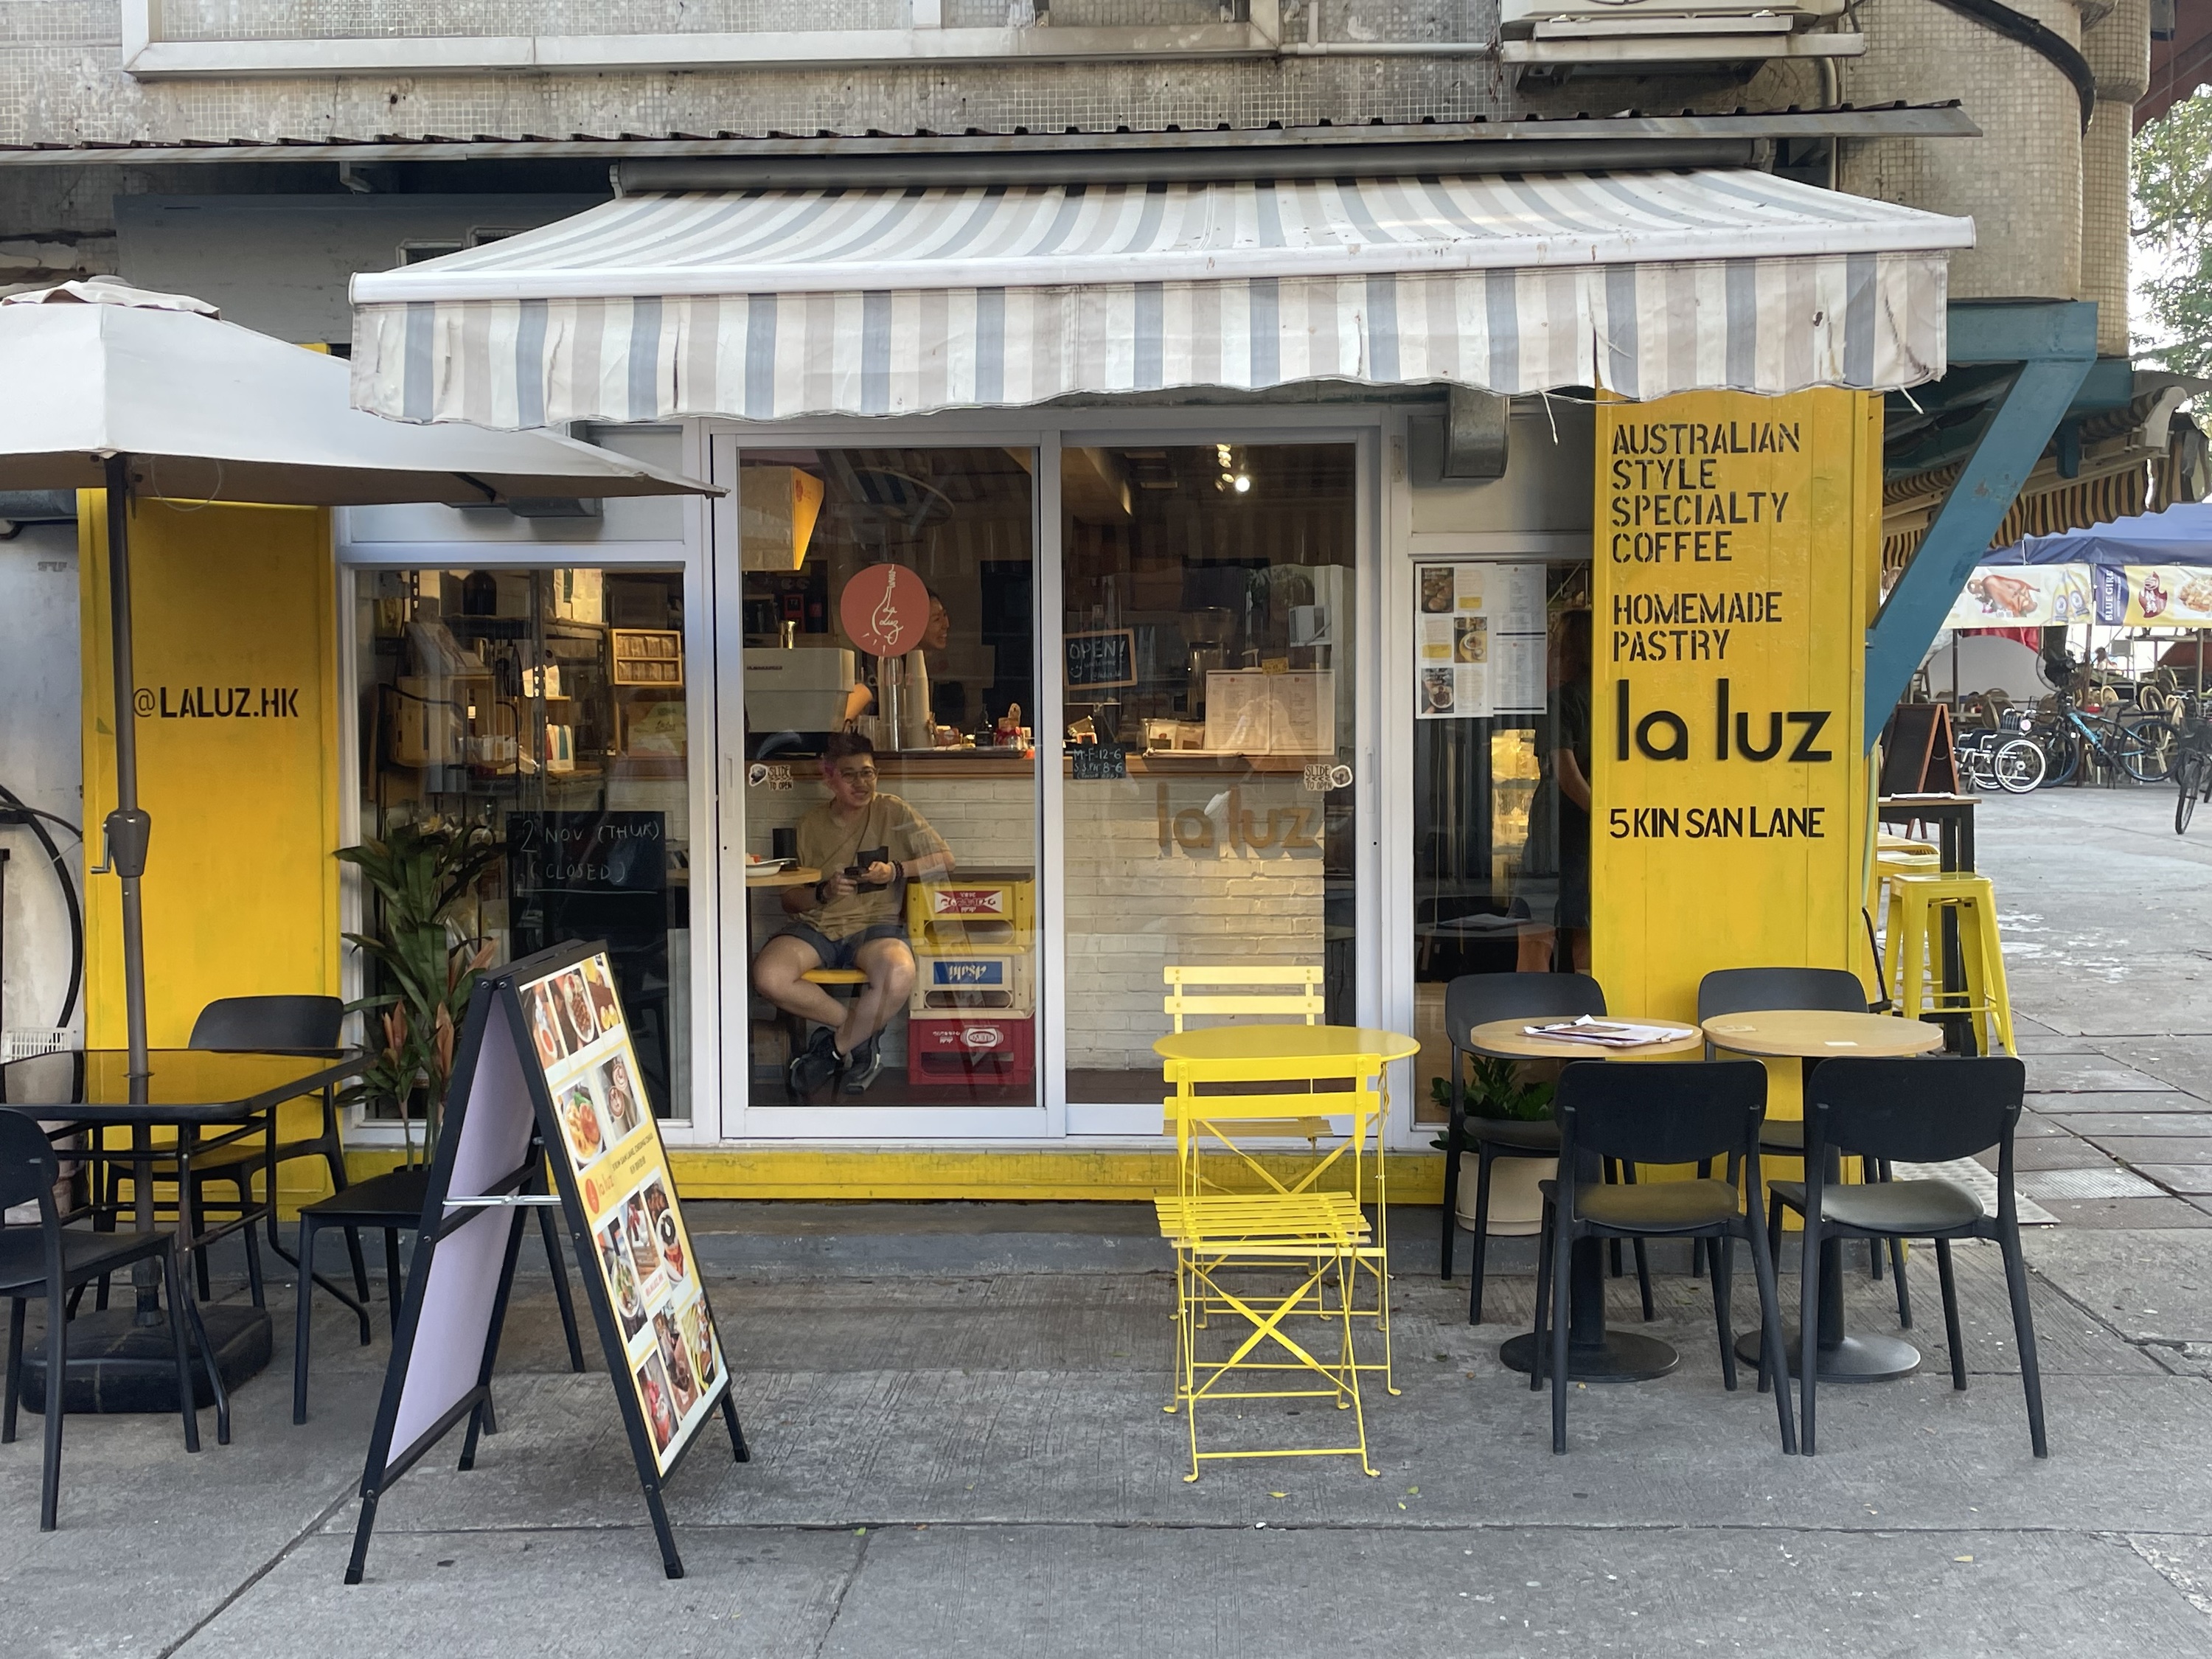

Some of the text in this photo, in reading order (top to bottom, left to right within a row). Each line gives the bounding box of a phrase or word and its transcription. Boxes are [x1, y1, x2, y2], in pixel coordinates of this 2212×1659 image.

[1613, 421, 1800, 455] AUSTRALIAN
[1612, 458, 1717, 490] STYLE
[1612, 491, 1789, 527] SPECIALTY
[1613, 530, 1733, 563] COFFEE
[1613, 591, 1783, 625] HOMEMADE
[2104, 597, 2115, 621] BLUE
[1069, 640, 1126, 659] OPEN!
[1613, 629, 1730, 662] PASTRY
[133, 686, 299, 718] @LALUZ.HK
[1616, 678, 1832, 762] la luz
[768, 765, 791, 778] SLIDE
[1102, 762, 1123, 773] 8-6
[1305, 765, 1330, 777] SLIDE
[769, 782, 793, 790] TO OPEN
[1306, 781, 1333, 790] TO OPEN
[1157, 782, 1315, 849] la luz
[1610, 806, 1825, 838] 5 KIN SAN LANE
[520, 819, 538, 853] 2
[545, 827, 584, 844] NOV
[949, 964, 987, 981] Asahi
